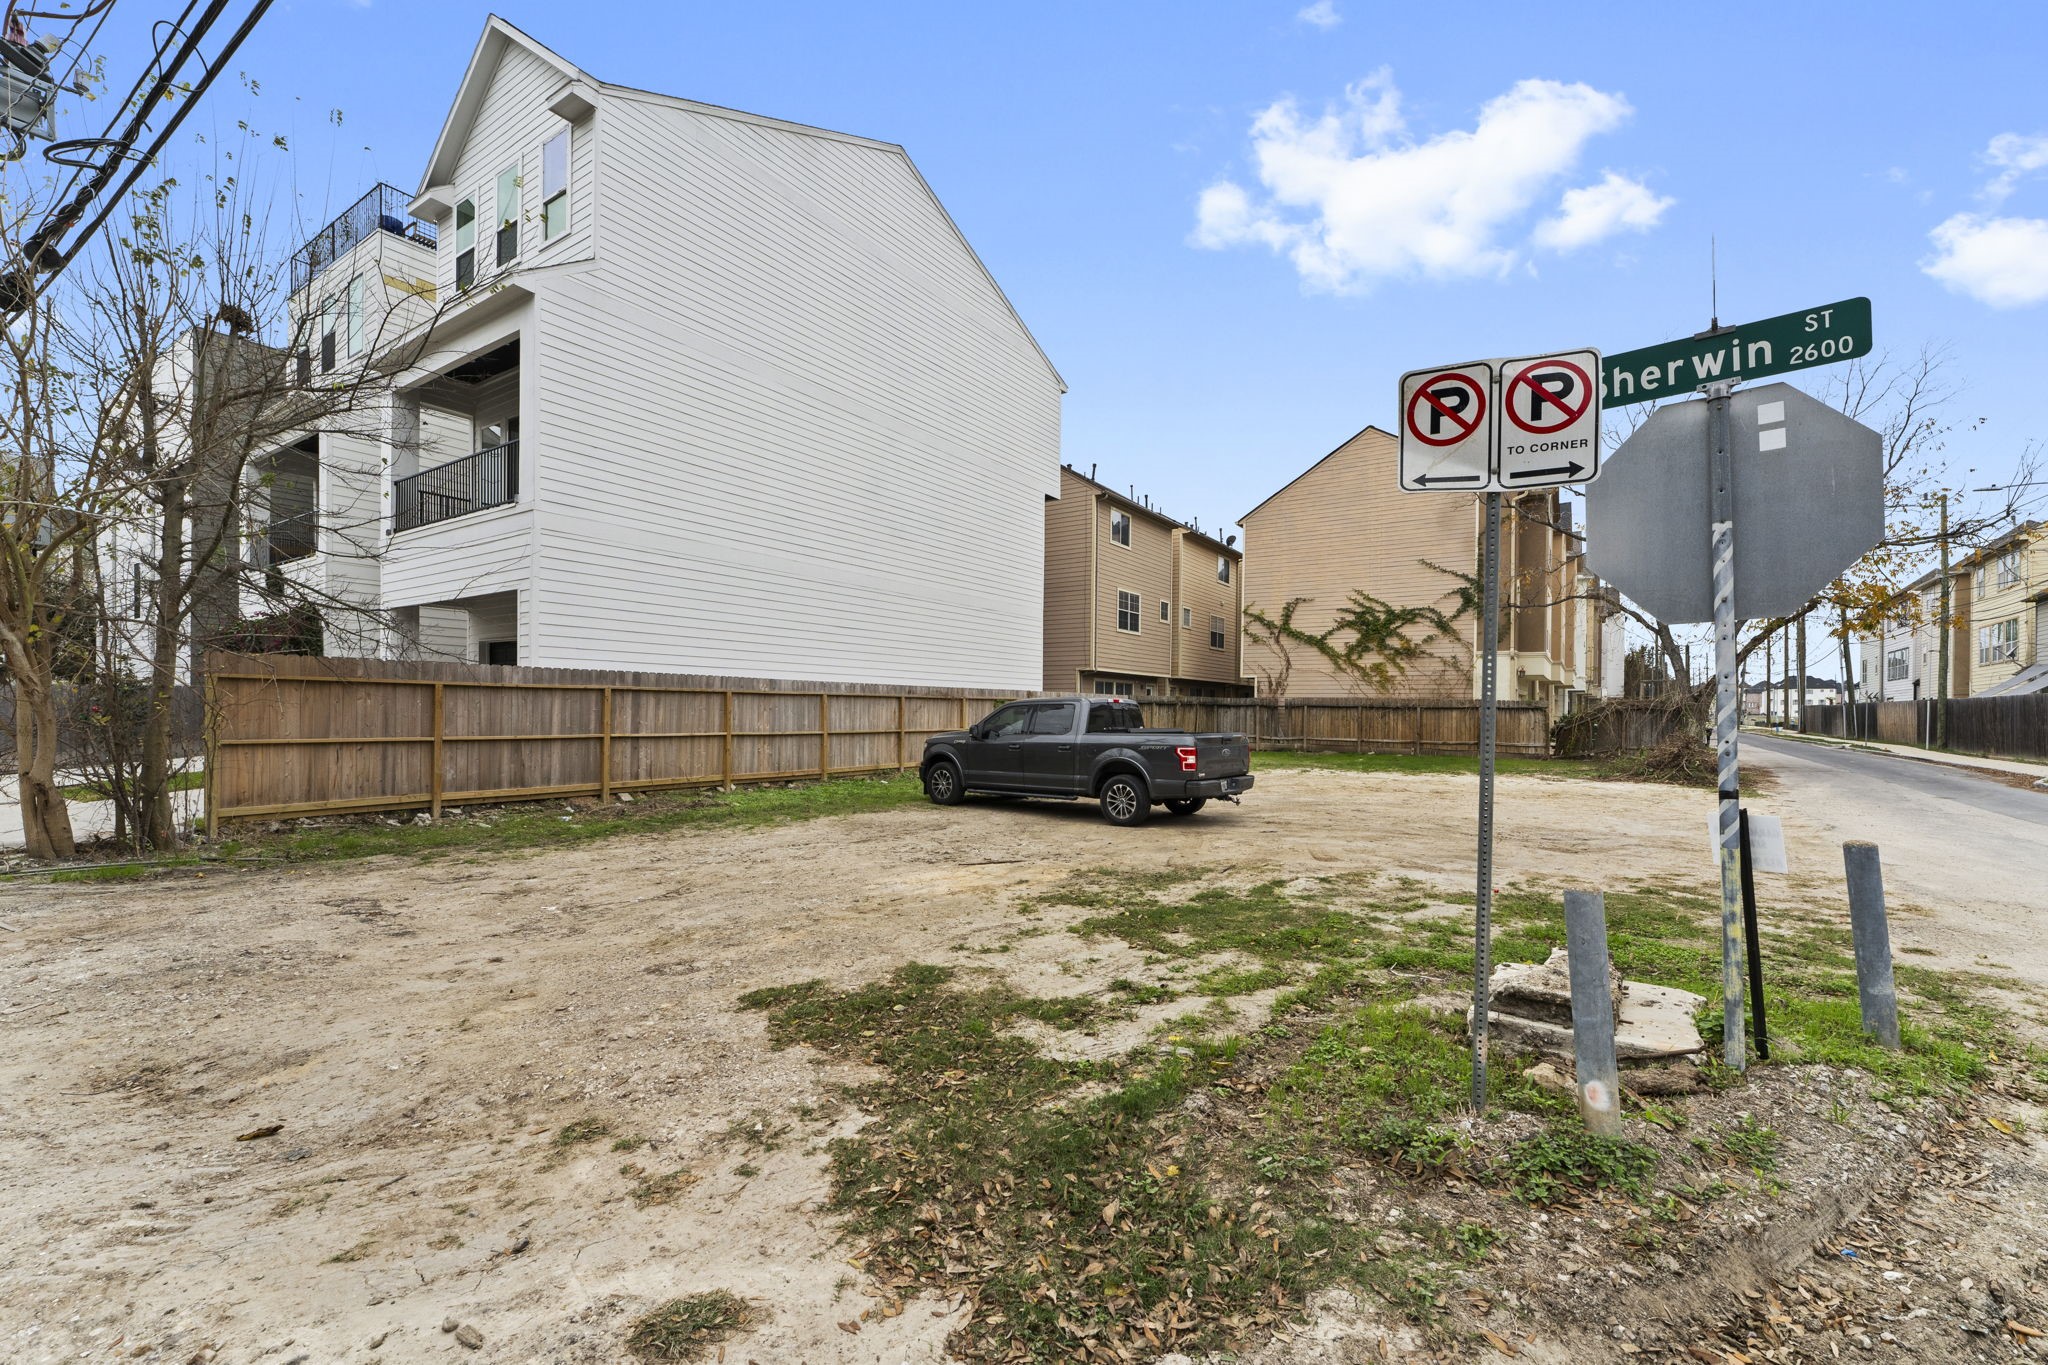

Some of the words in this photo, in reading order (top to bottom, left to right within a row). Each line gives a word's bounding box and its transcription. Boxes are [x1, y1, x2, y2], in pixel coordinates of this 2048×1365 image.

[1804, 309, 1834, 332] ST
[1789, 335, 1854, 365] 2600
[1507, 444, 1525, 456] TO
[1530, 438, 1589, 453] CORNER
